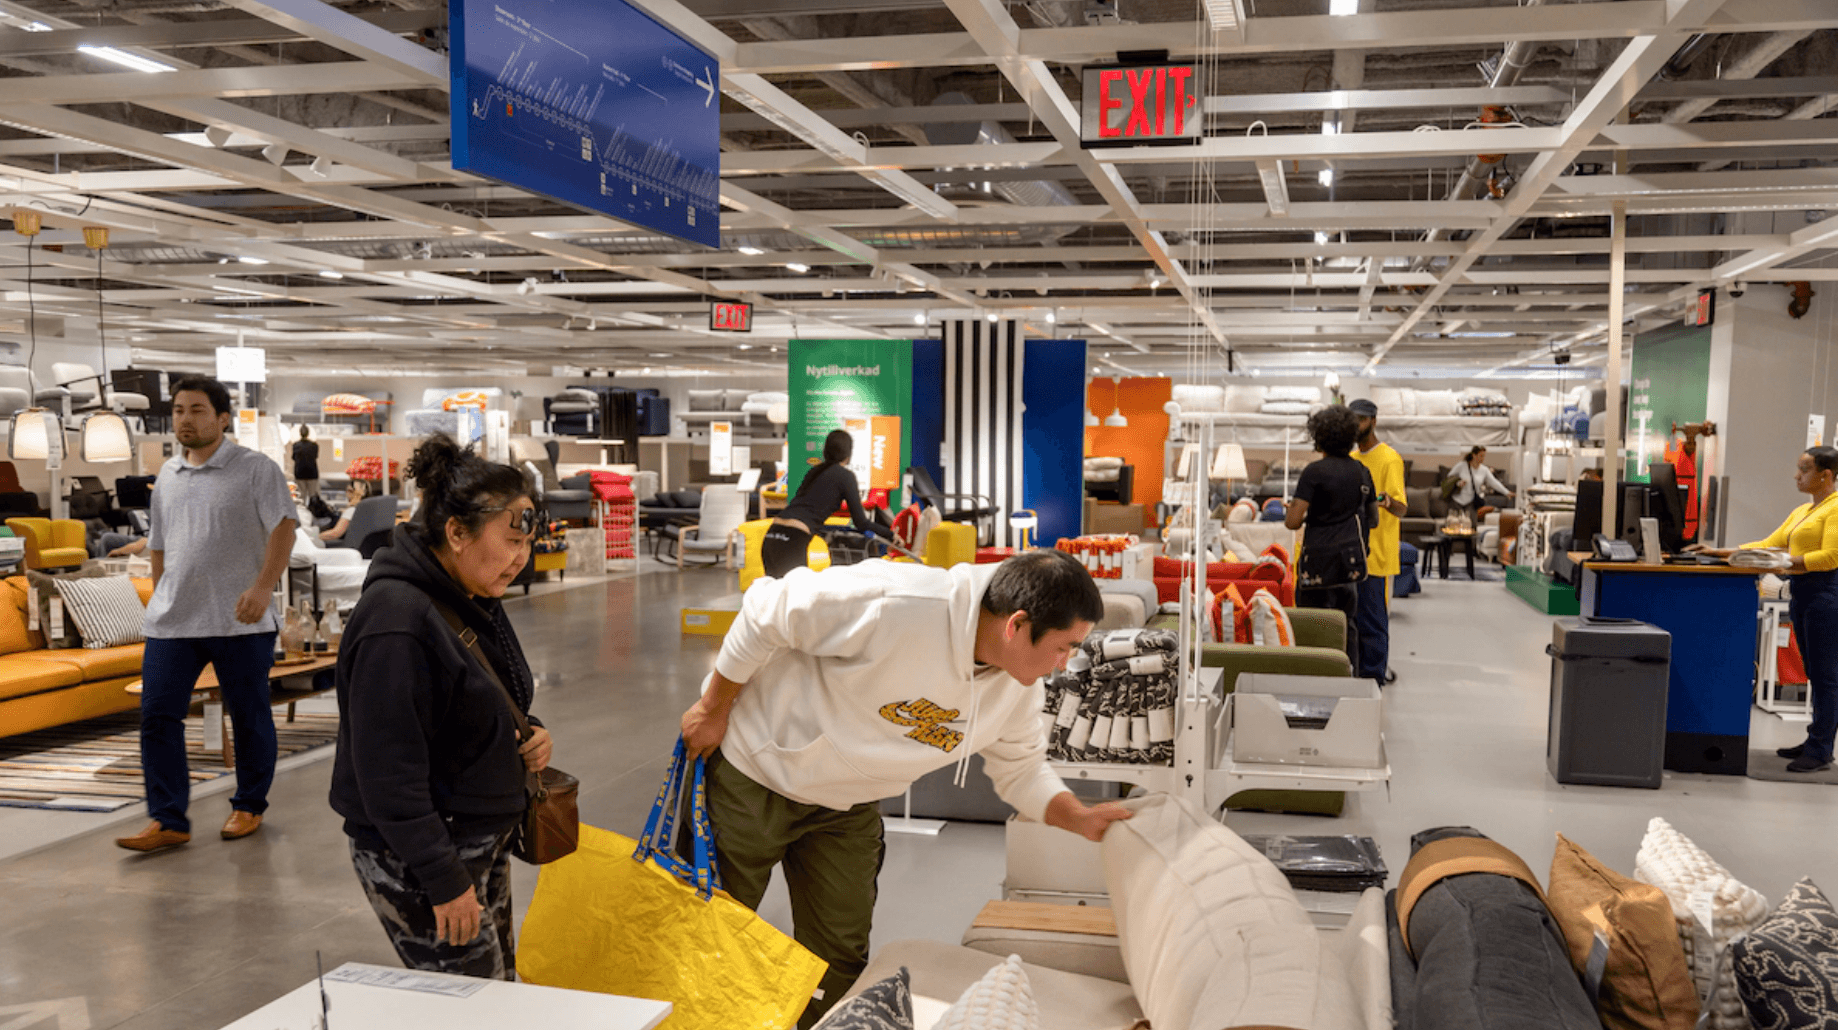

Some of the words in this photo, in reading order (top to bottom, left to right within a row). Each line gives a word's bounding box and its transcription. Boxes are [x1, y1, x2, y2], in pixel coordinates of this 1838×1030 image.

[1099, 67, 1192, 138] EXIT
[715, 304, 749, 330] EXIT
[806, 364, 881, 379] Nytillverkad
[872, 435, 888, 470] New
